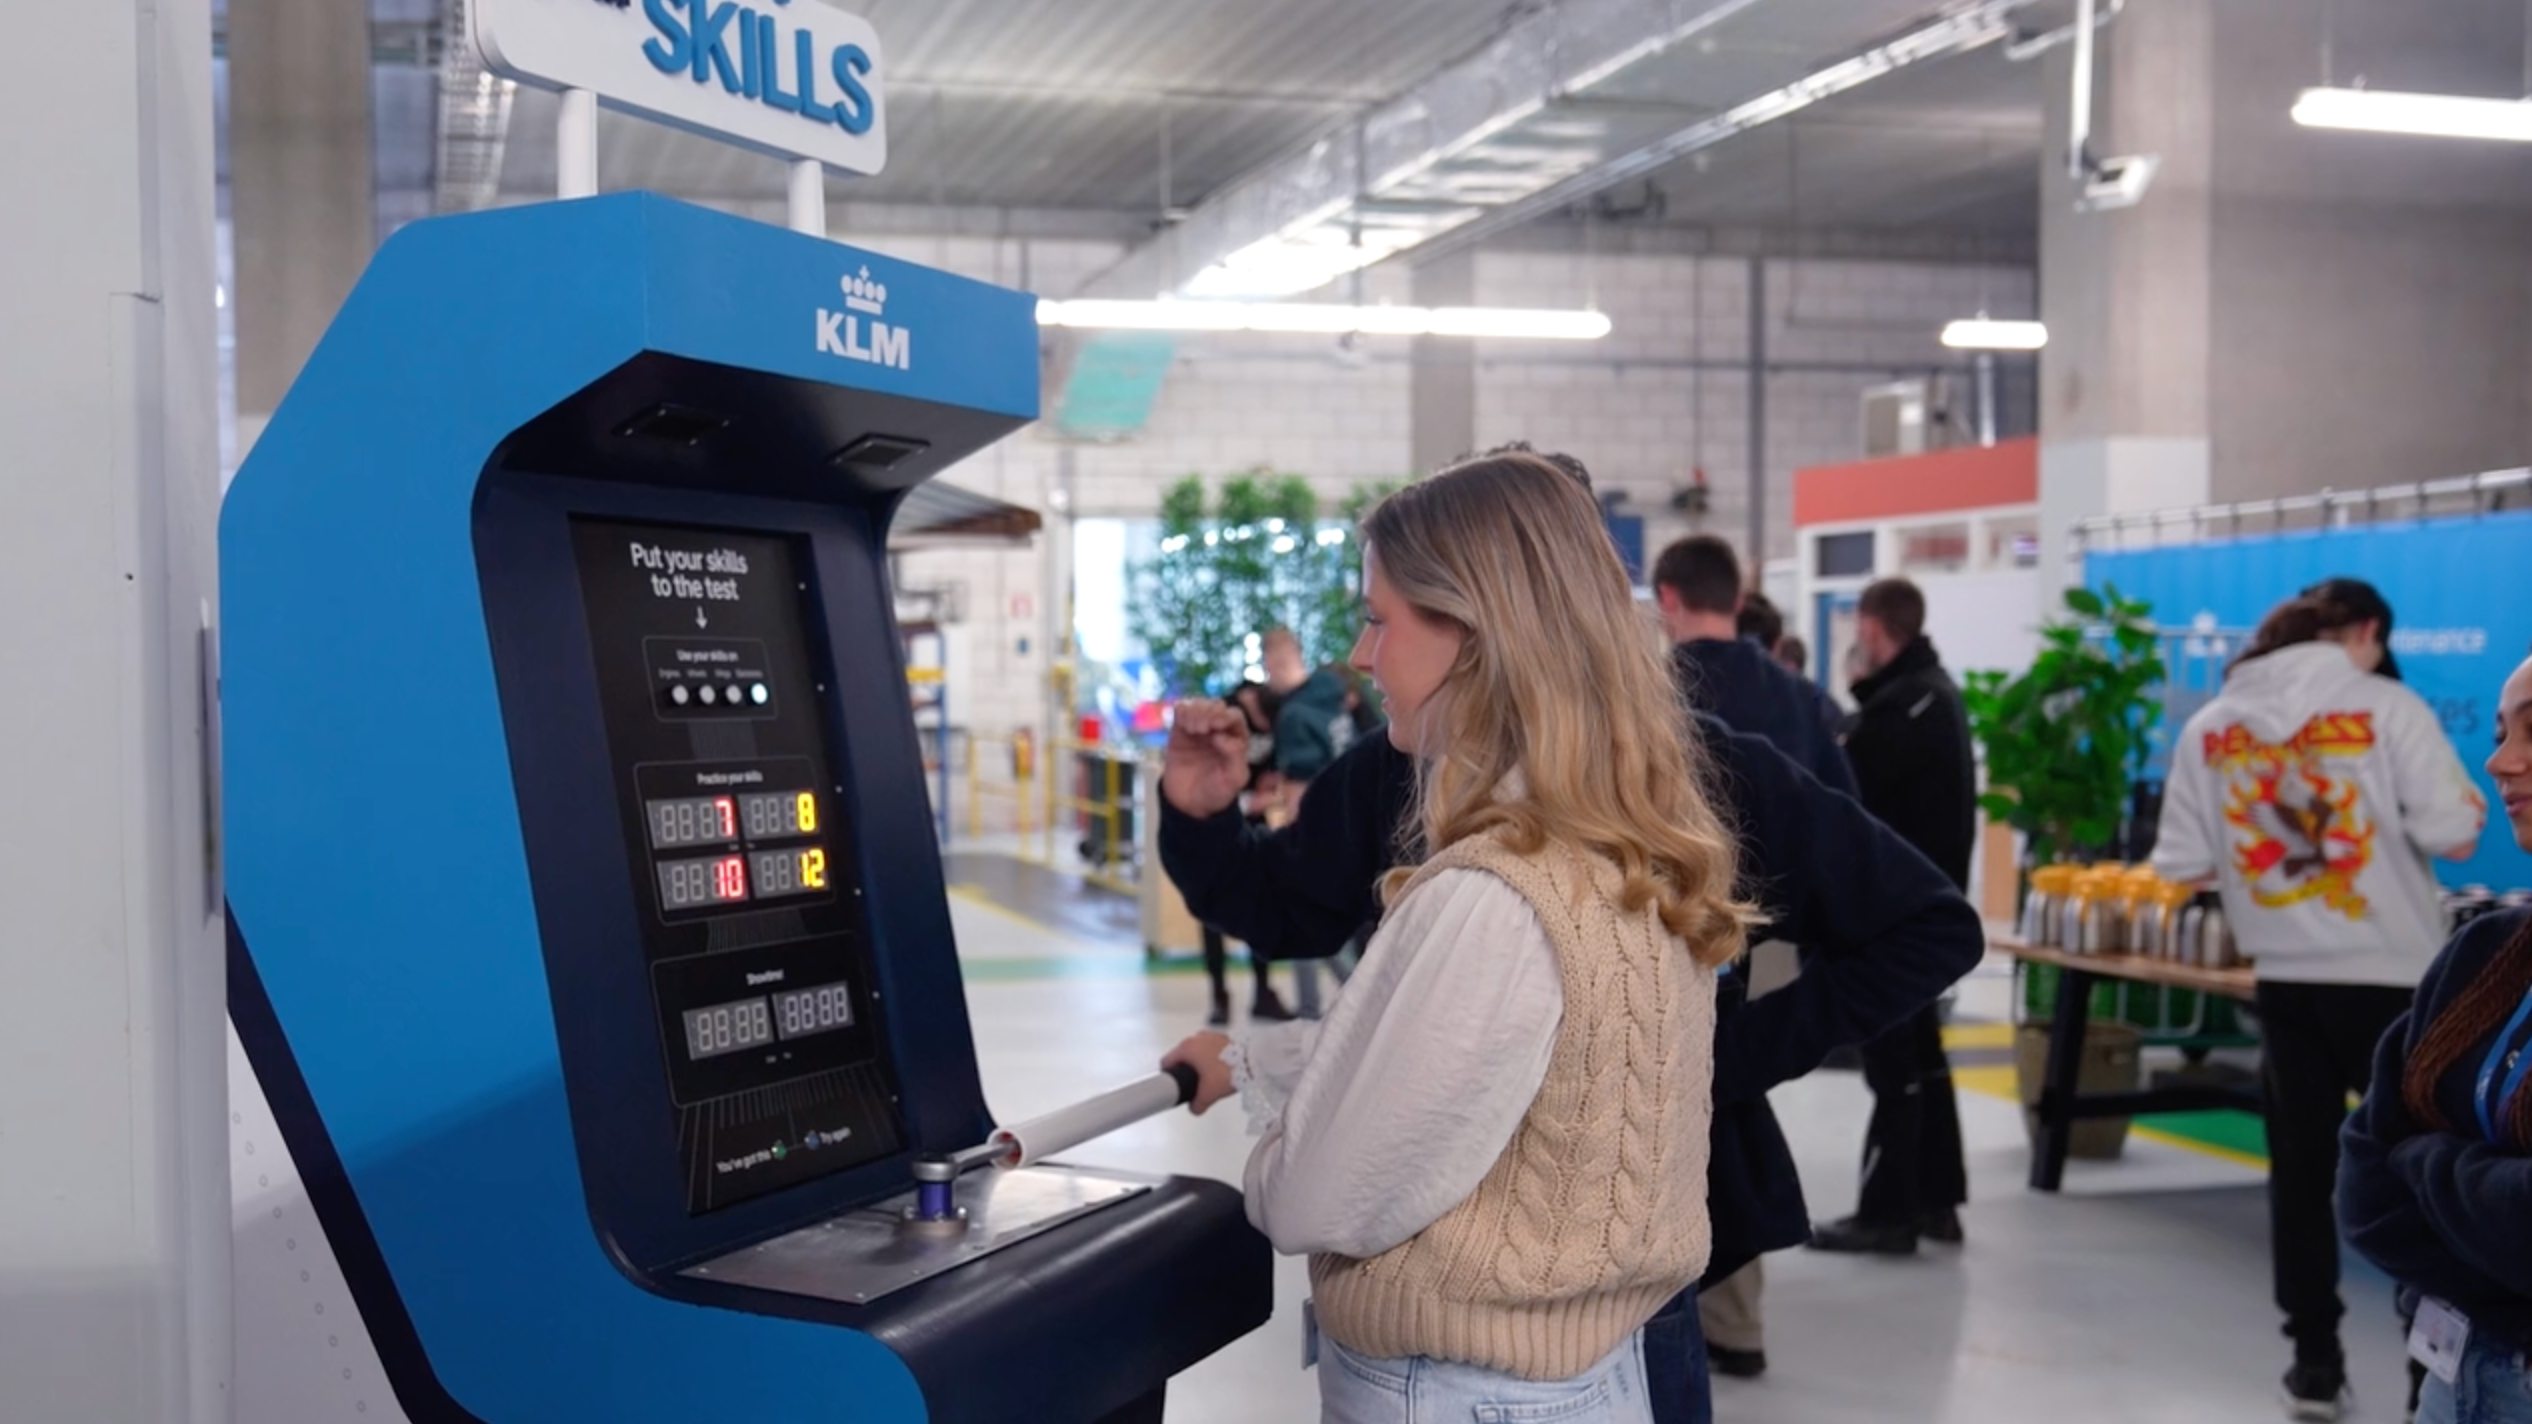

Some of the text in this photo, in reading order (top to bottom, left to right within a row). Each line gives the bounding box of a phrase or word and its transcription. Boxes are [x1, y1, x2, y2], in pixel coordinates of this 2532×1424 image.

[642, 0, 873, 134] SKILLS
[816, 308, 909, 370] KLM
[630, 542, 749, 574] Put your skills
[651, 572, 740, 601] to the test
[2389, 627, 2486, 653] ntenance
[698, 773, 727, 784] Practice
[727, 772, 743, 786] your
[714, 799, 734, 838] 7
[797, 792, 816, 832] 8
[717, 858, 743, 897] 10
[801, 848, 825, 888] 12
[820, 1132, 832, 1144] Try
[743, 1152, 757, 1169] got
